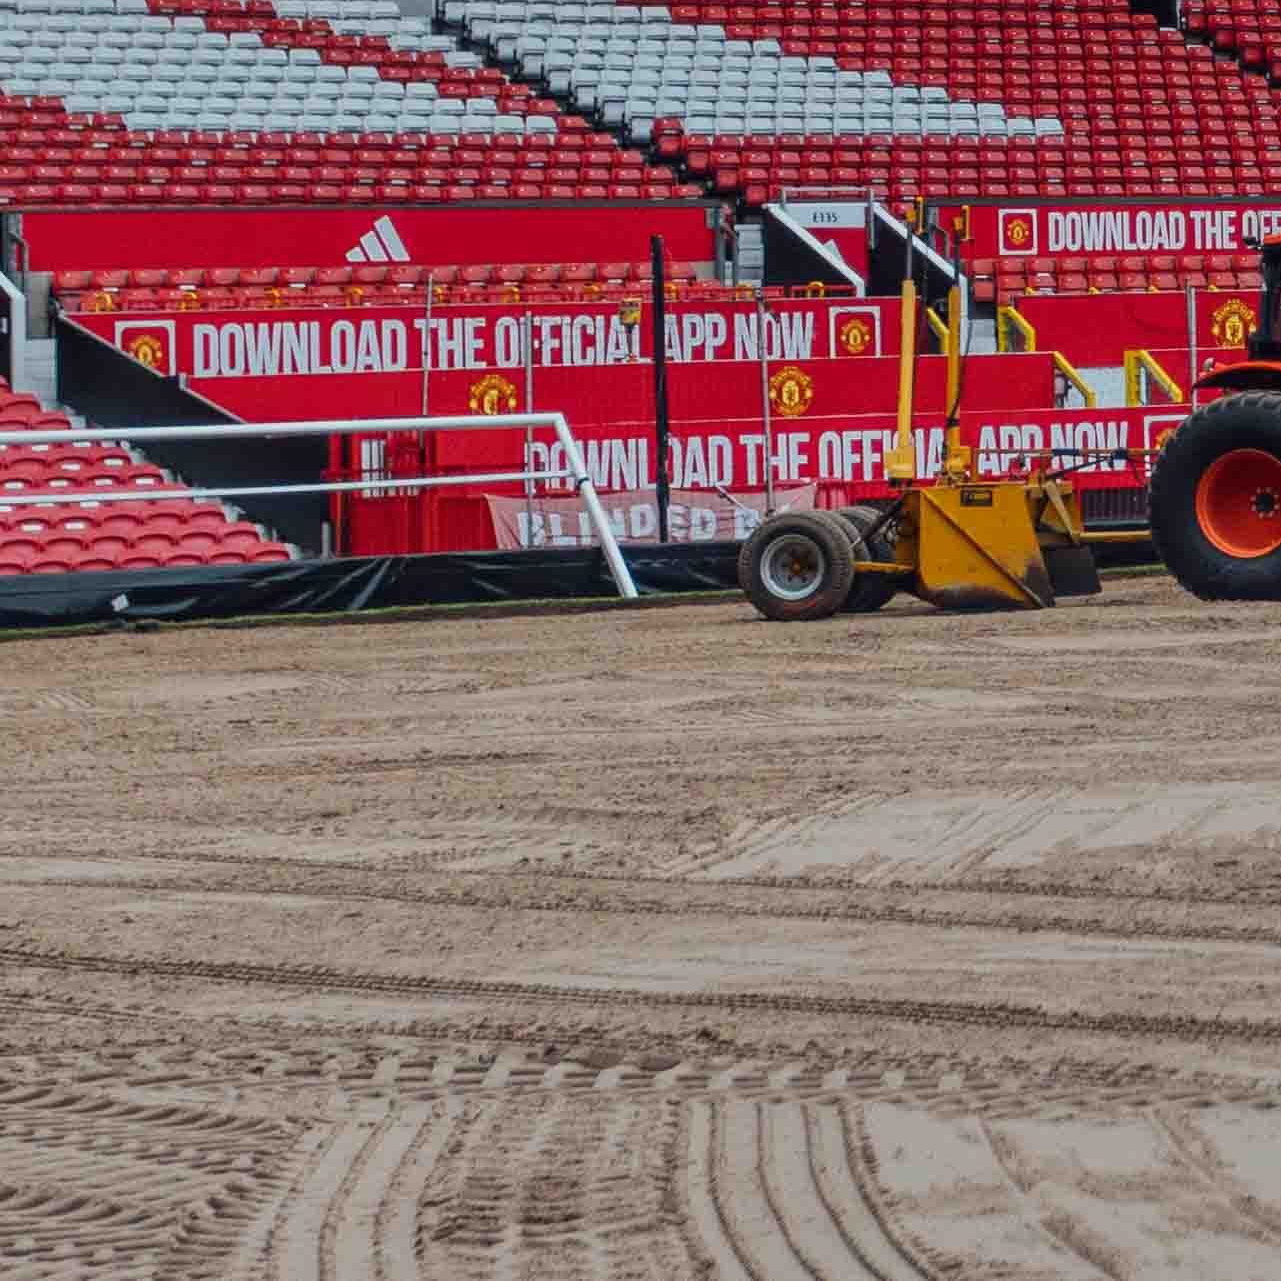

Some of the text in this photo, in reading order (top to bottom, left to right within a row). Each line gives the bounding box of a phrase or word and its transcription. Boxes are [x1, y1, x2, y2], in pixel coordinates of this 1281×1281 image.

[1047, 210, 1186, 252] DOWNLOAD
[1190, 209, 1238, 250] THE
[193, 319, 407, 378] DOWNLOAD
[414, 316, 487, 370] THE
[664, 313, 727, 364] APP
[734, 312, 814, 361] NOW
[739, 432, 811, 486] THE
[978, 424, 1043, 477] APP
[1051, 421, 1128, 474] NOW
